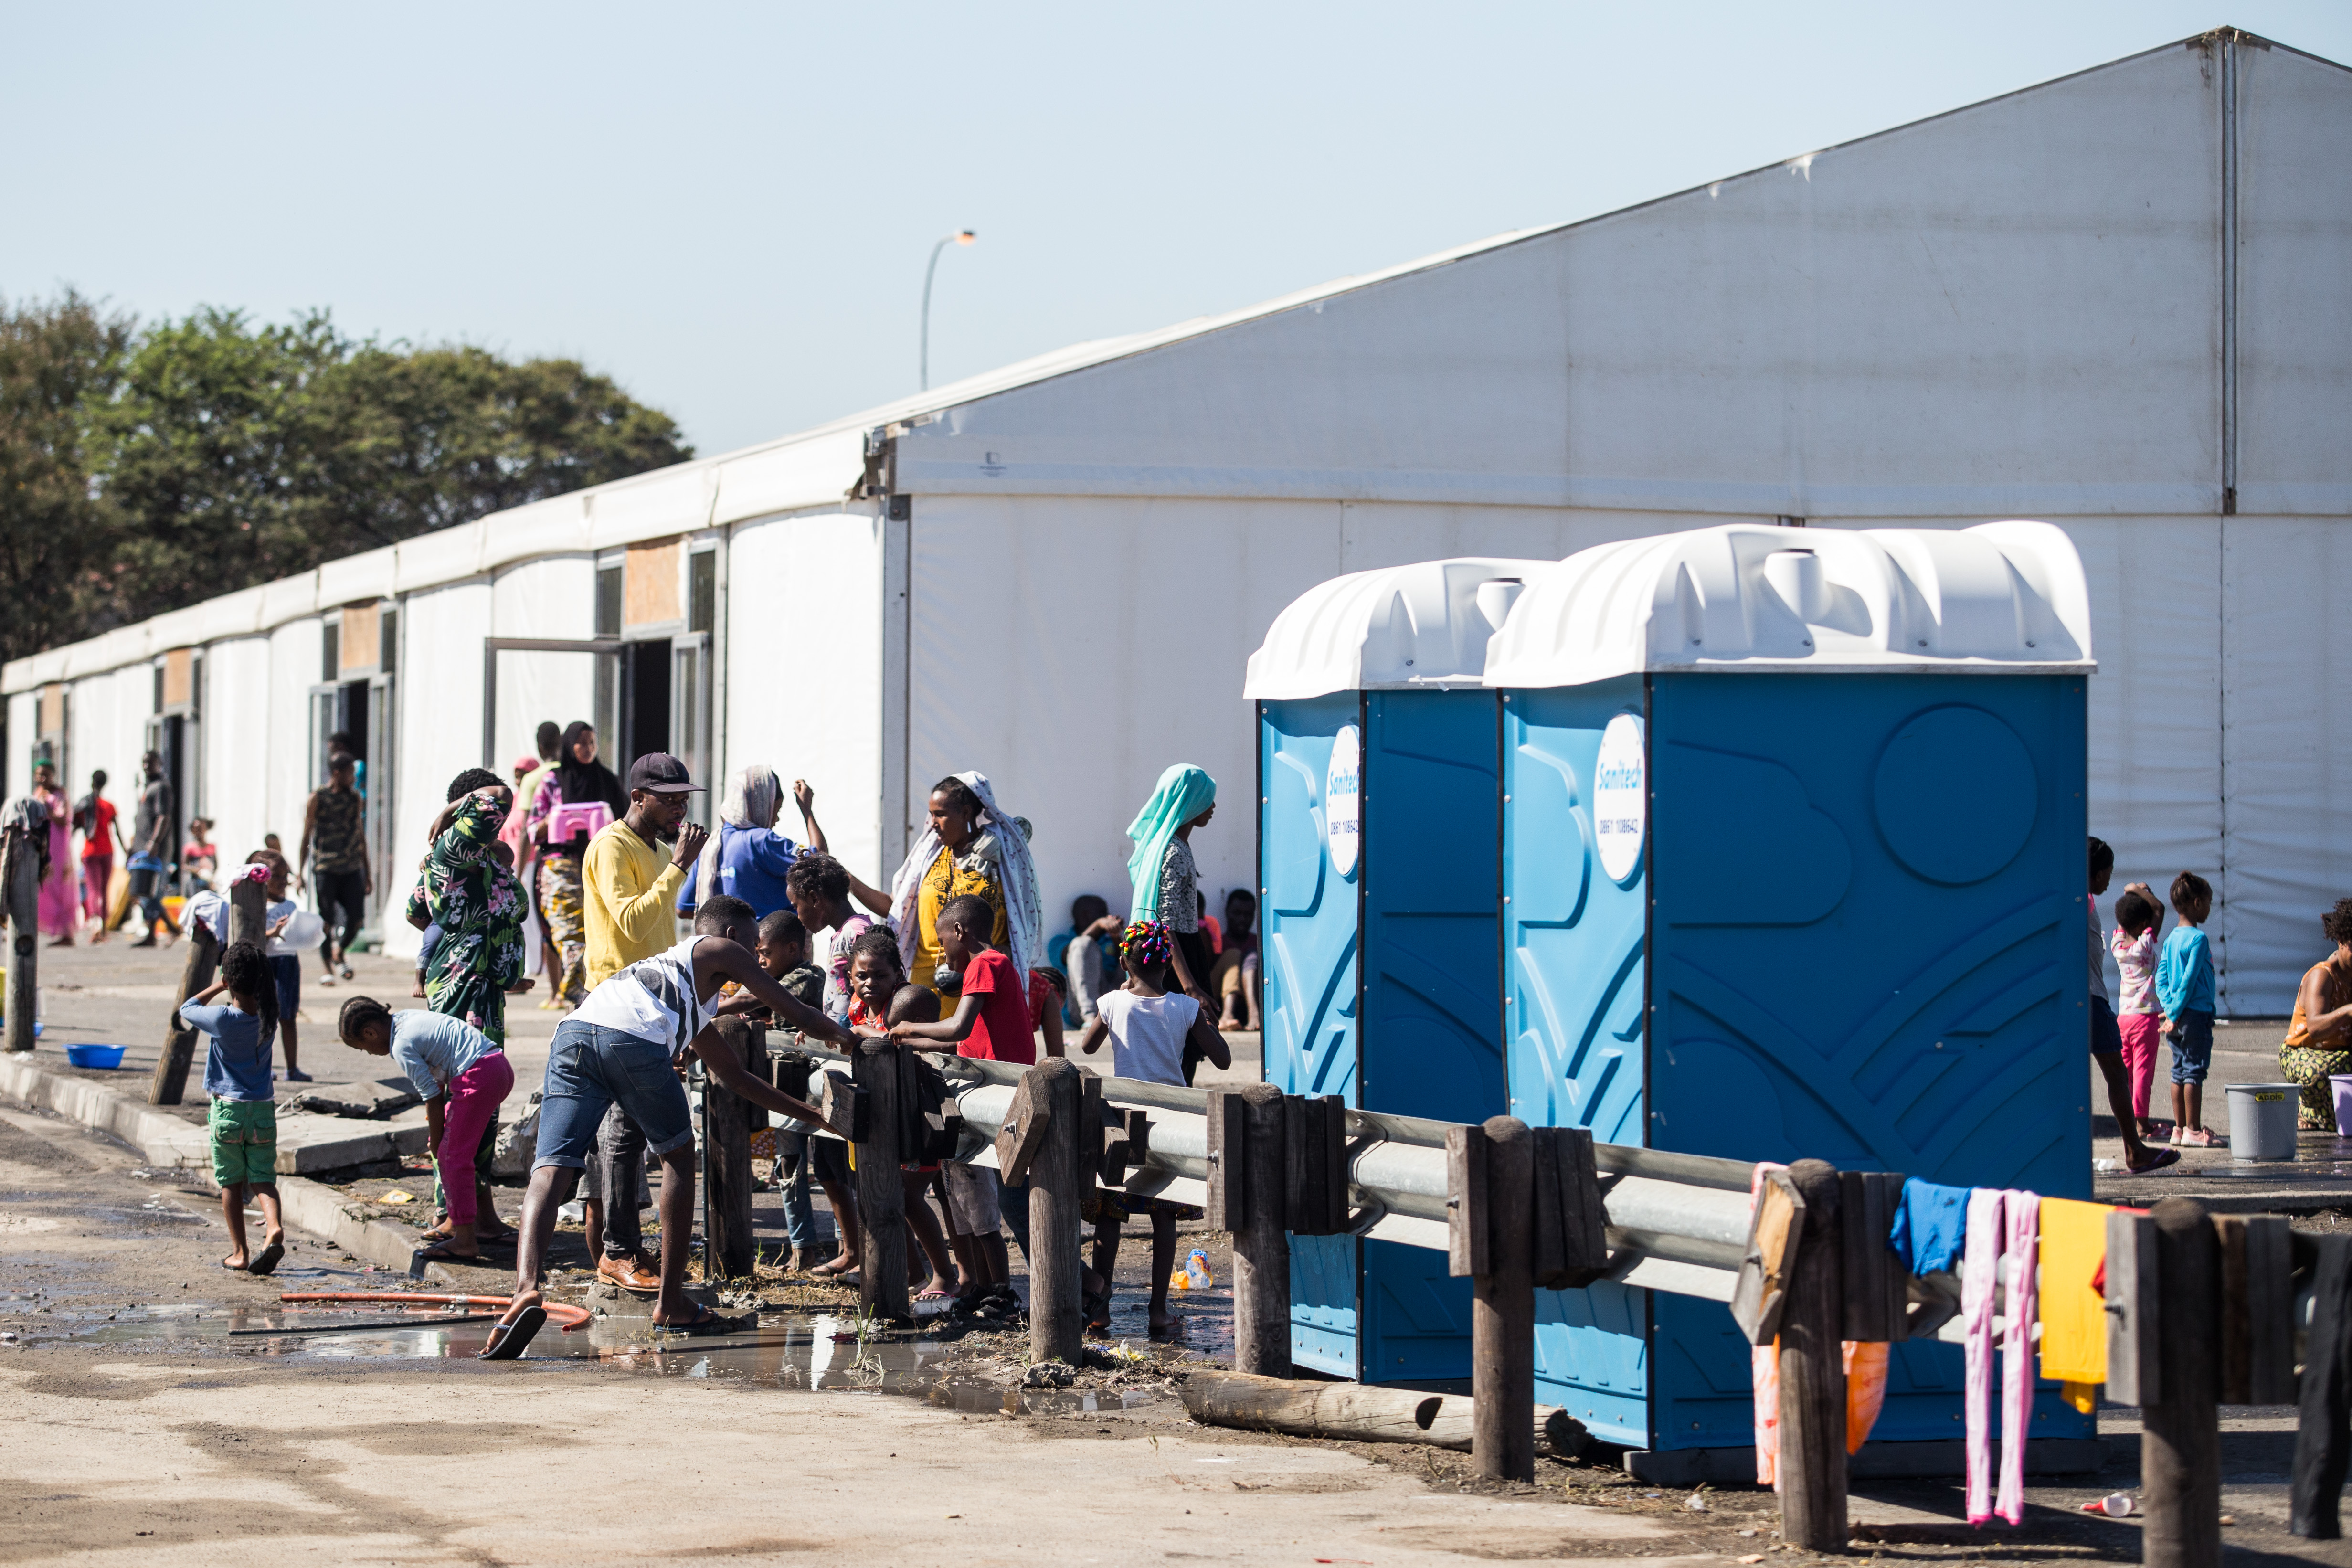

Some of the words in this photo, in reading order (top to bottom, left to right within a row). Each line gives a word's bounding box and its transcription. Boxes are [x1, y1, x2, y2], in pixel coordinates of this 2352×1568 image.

[659, 762, 678, 779] L
[1599, 759, 1641, 790] Sanitech
[1331, 821, 1341, 835] 0861
[1343, 819, 1358, 833] 108642
[1600, 819, 1613, 834] 0861
[1616, 819, 1638, 833] 108642
